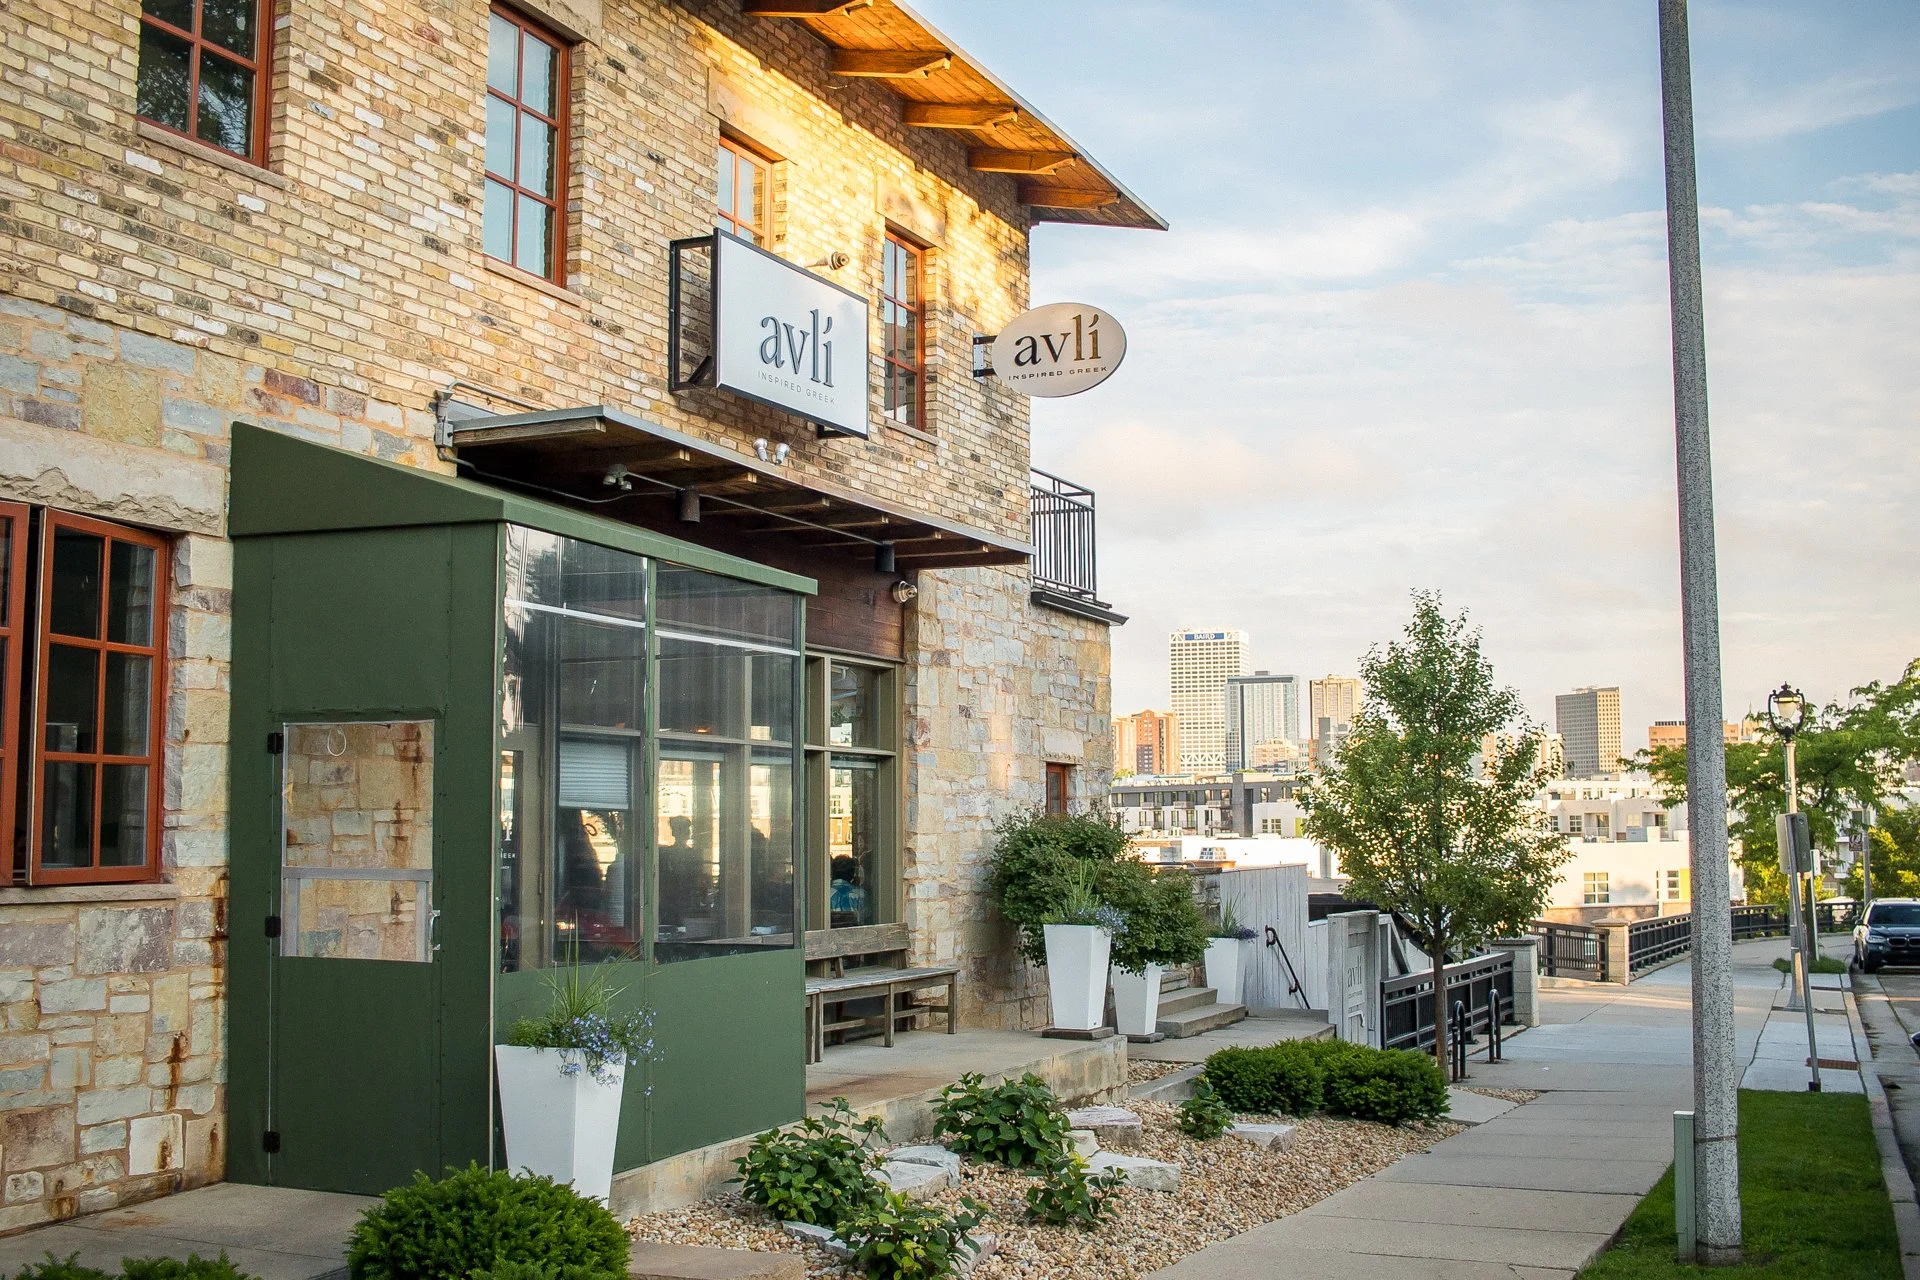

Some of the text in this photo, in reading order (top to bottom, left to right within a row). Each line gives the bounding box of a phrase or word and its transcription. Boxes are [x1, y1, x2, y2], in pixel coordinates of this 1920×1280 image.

[1008, 366, 1108, 381] INSPIRED GREEK
[758, 370, 836, 405] INSPIRED GREEK
[1194, 632, 1216, 640] BAIRD
